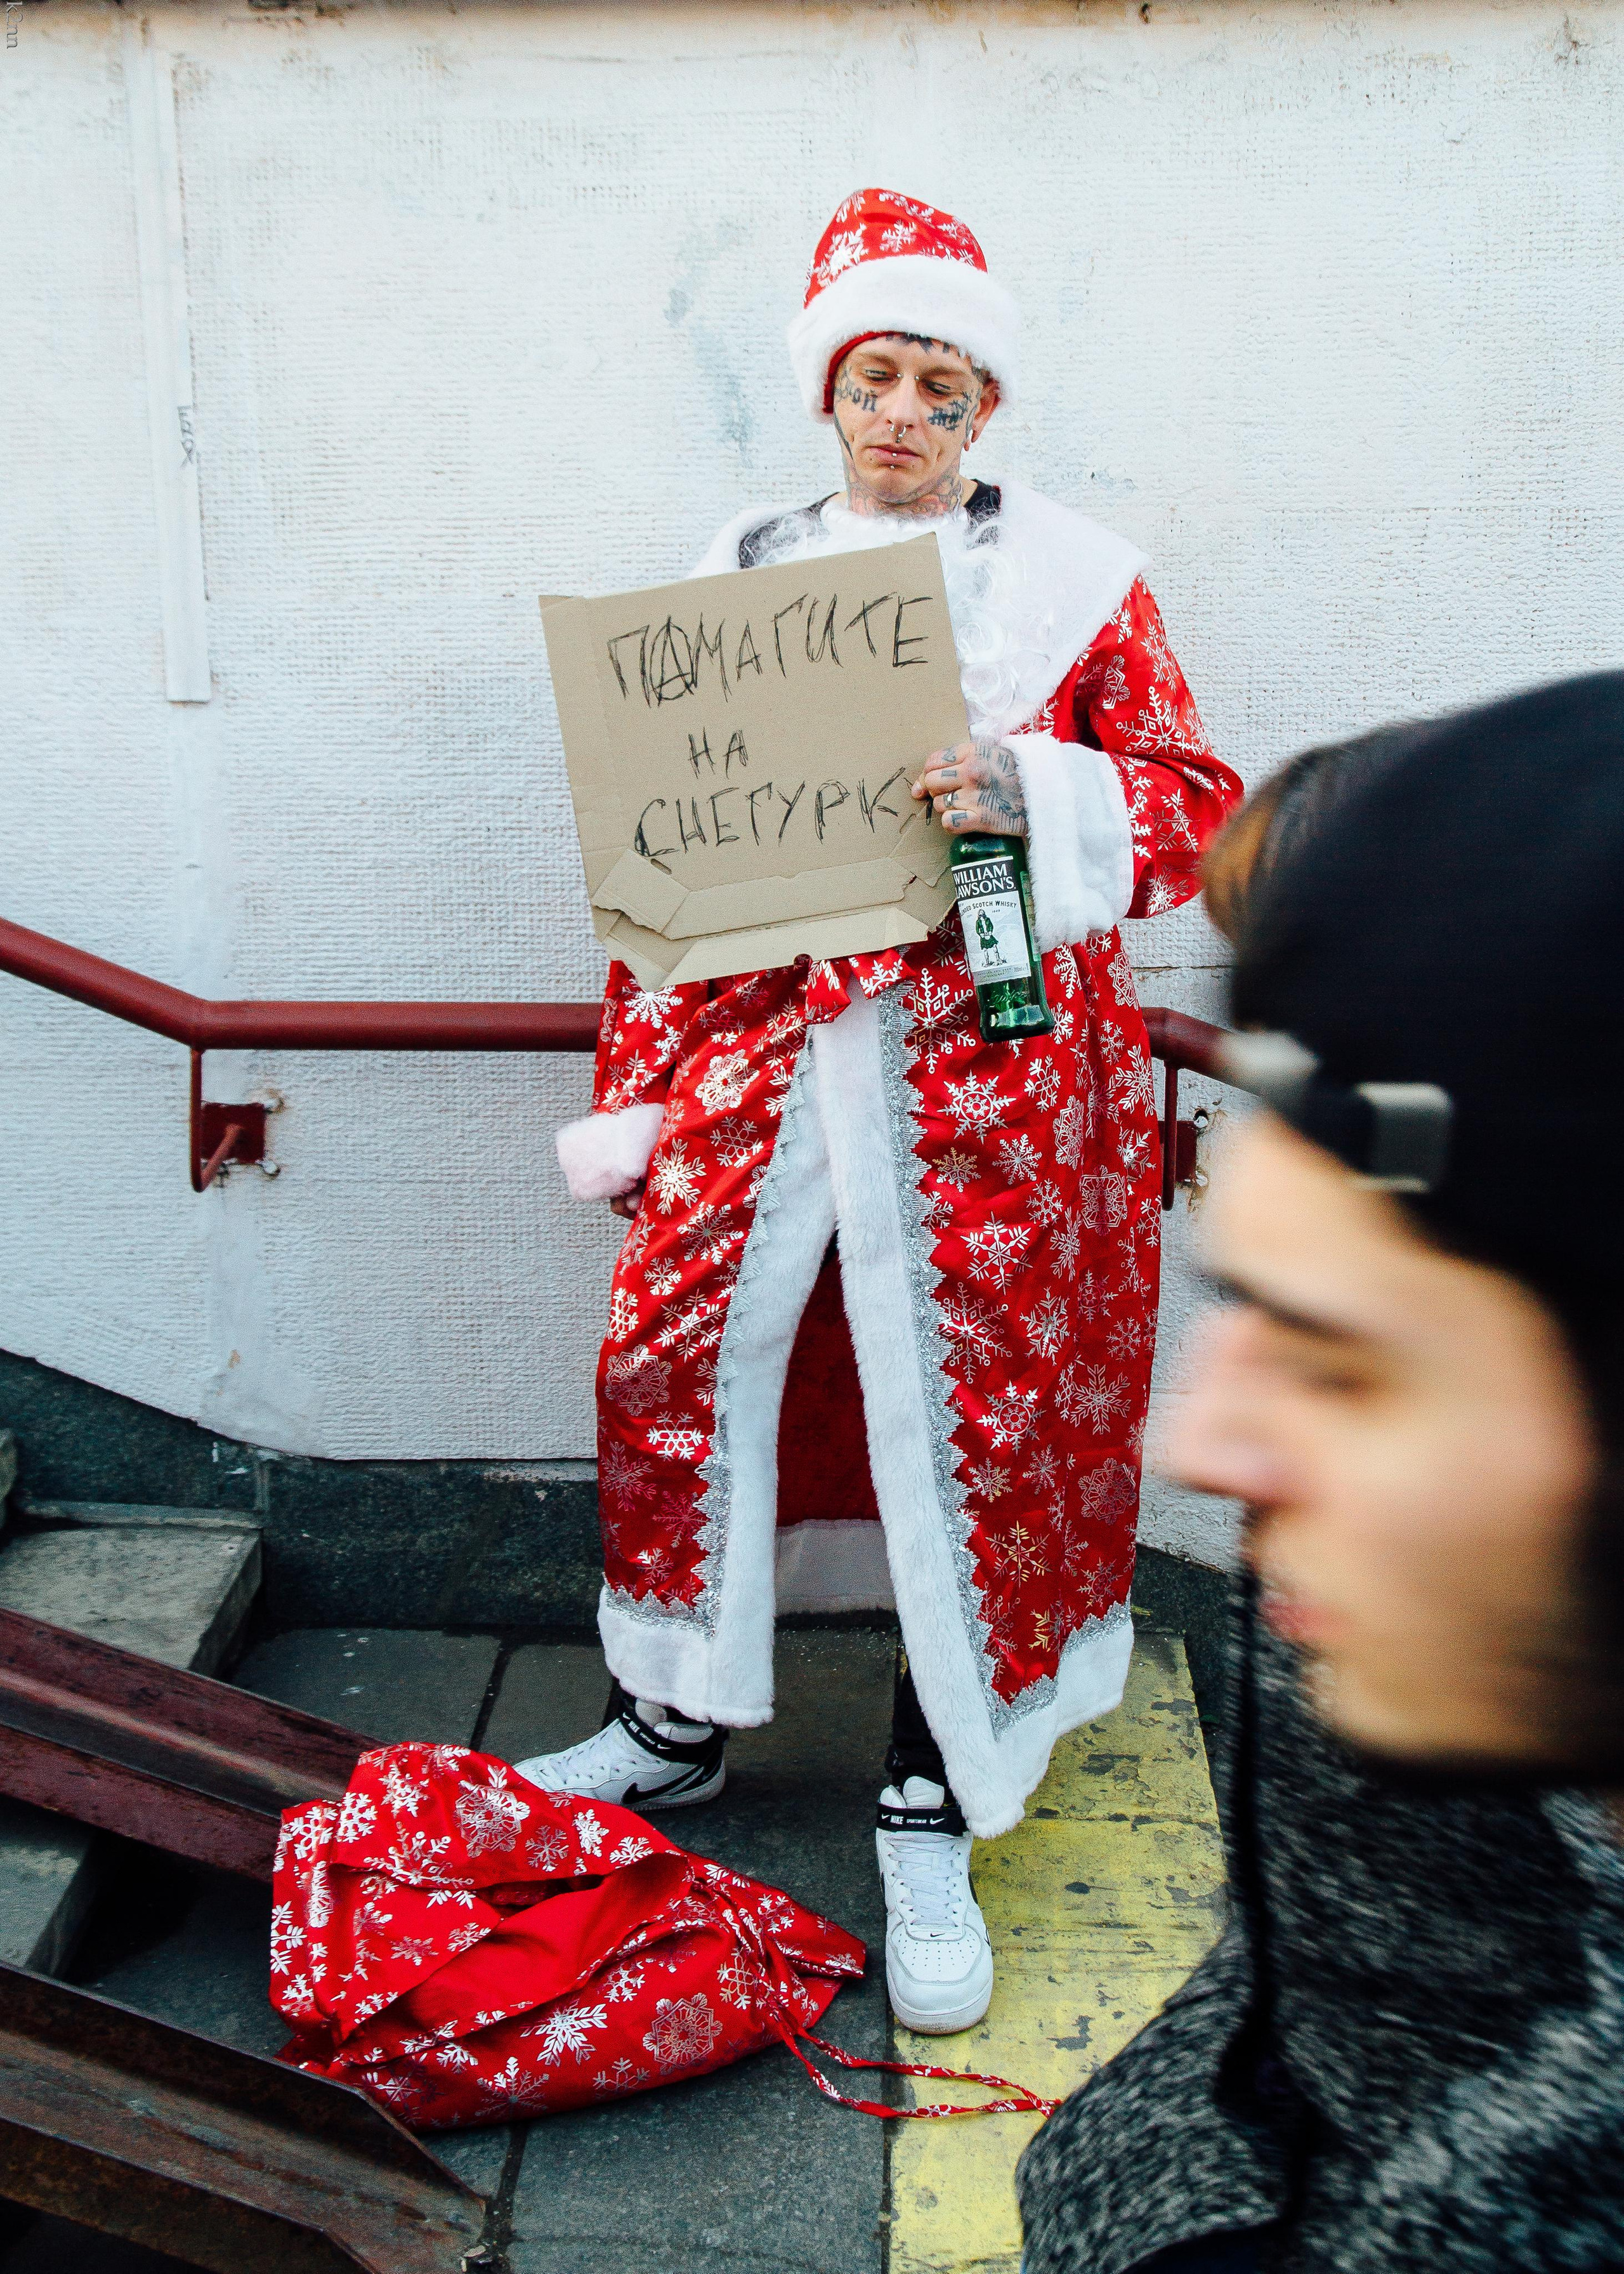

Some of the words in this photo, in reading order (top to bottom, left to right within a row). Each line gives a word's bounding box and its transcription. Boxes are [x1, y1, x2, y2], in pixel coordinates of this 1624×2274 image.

[688, 726, 749, 779] НА
[972, 901, 993, 909] SCOTCH
[995, 900, 1017, 909] WHISKY
[890, 1815, 904, 1825] NIKE
